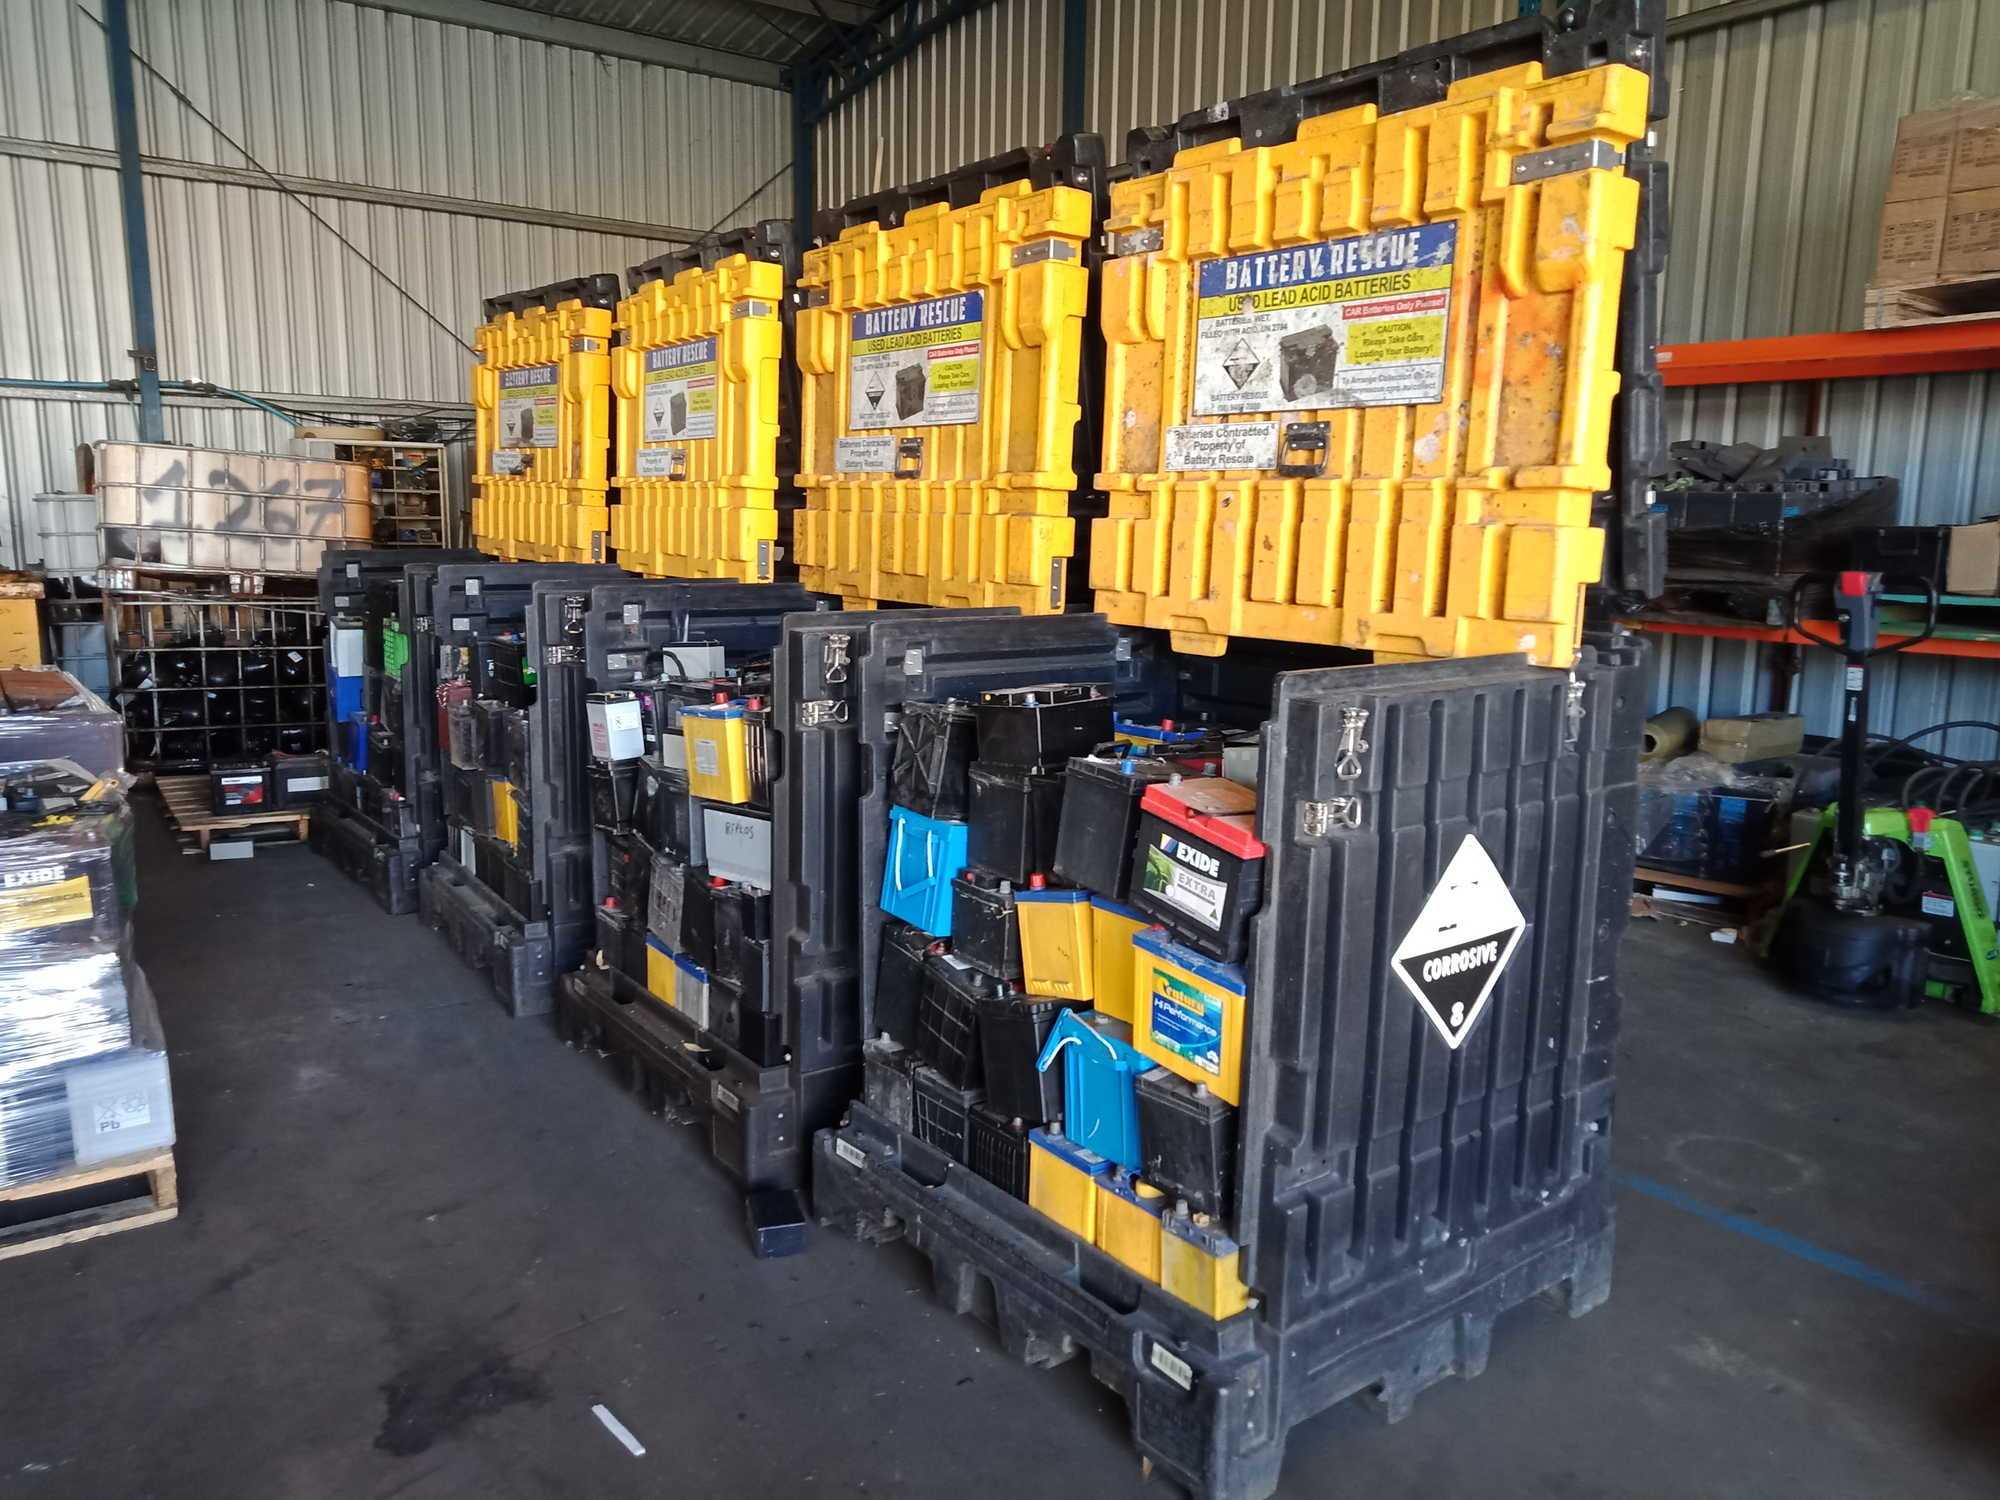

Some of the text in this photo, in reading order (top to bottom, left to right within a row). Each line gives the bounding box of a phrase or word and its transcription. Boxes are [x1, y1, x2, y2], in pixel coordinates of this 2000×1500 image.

[1225, 231, 1420, 290] BATTERY RESCUE
[1229, 273, 1411, 312] USD LEAD ACID BATTERIES
[865, 296, 966, 336] BATTERY RESCUE
[1376, 322, 1412, 334] CAUTION
[886, 335, 904, 350] LEAD
[905, 333, 921, 347] ACID
[922, 327, 962, 344] BATTERIES
[653, 341, 708, 369] BATTERY RESCUE
[1216, 425, 1270, 439] Contracted
[1193, 439, 1246, 452] Property of
[1184, 454, 1254, 466] Battery Rescue
[1176, 841, 1220, 878] EXIDE
[4, 865, 66, 888] EXIDE
[1178, 872, 1216, 901] EXTRA
[1423, 940, 1498, 982] CORROSIVE
[1450, 1001, 1465, 1027] 8
[100, 1120, 121, 1132] Pb
